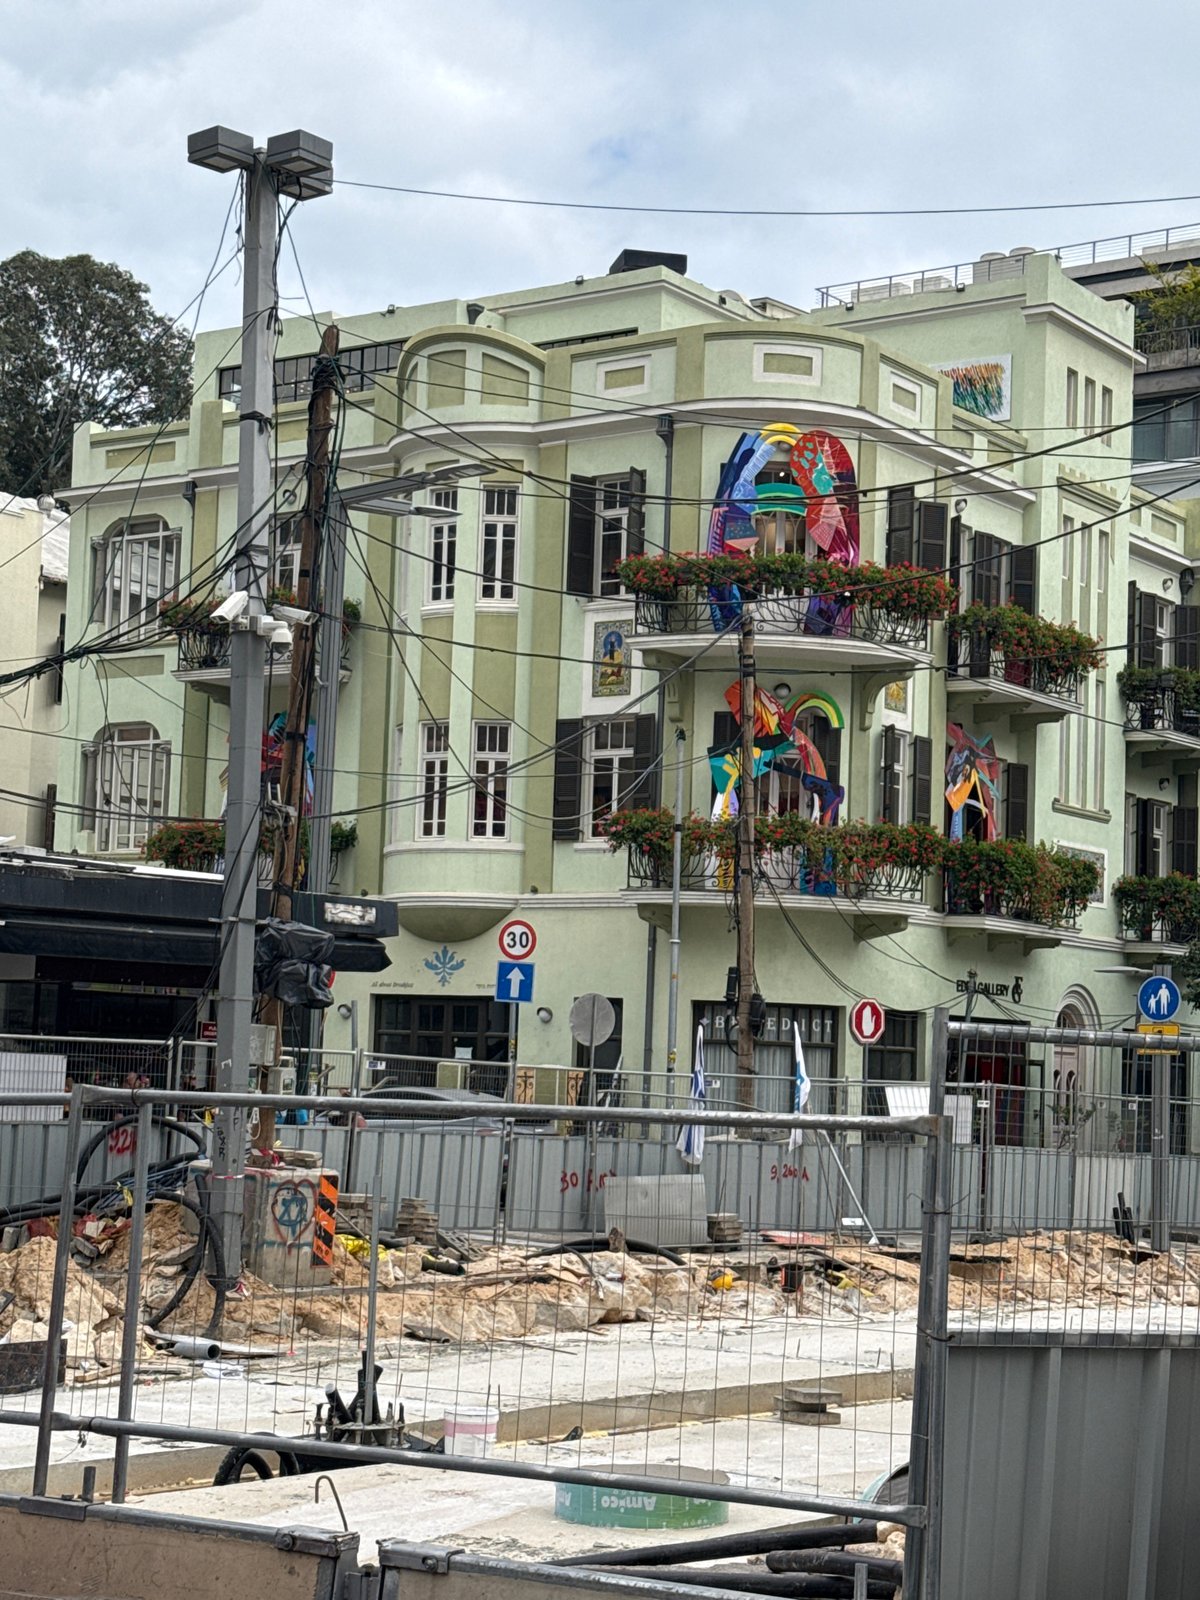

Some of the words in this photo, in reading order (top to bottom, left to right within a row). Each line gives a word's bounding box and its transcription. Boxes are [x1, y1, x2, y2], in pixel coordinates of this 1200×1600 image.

[506, 931, 530, 949] 30
[978, 981, 1010, 997] GALLERY
[601, 1495, 657, 1513] Amico
